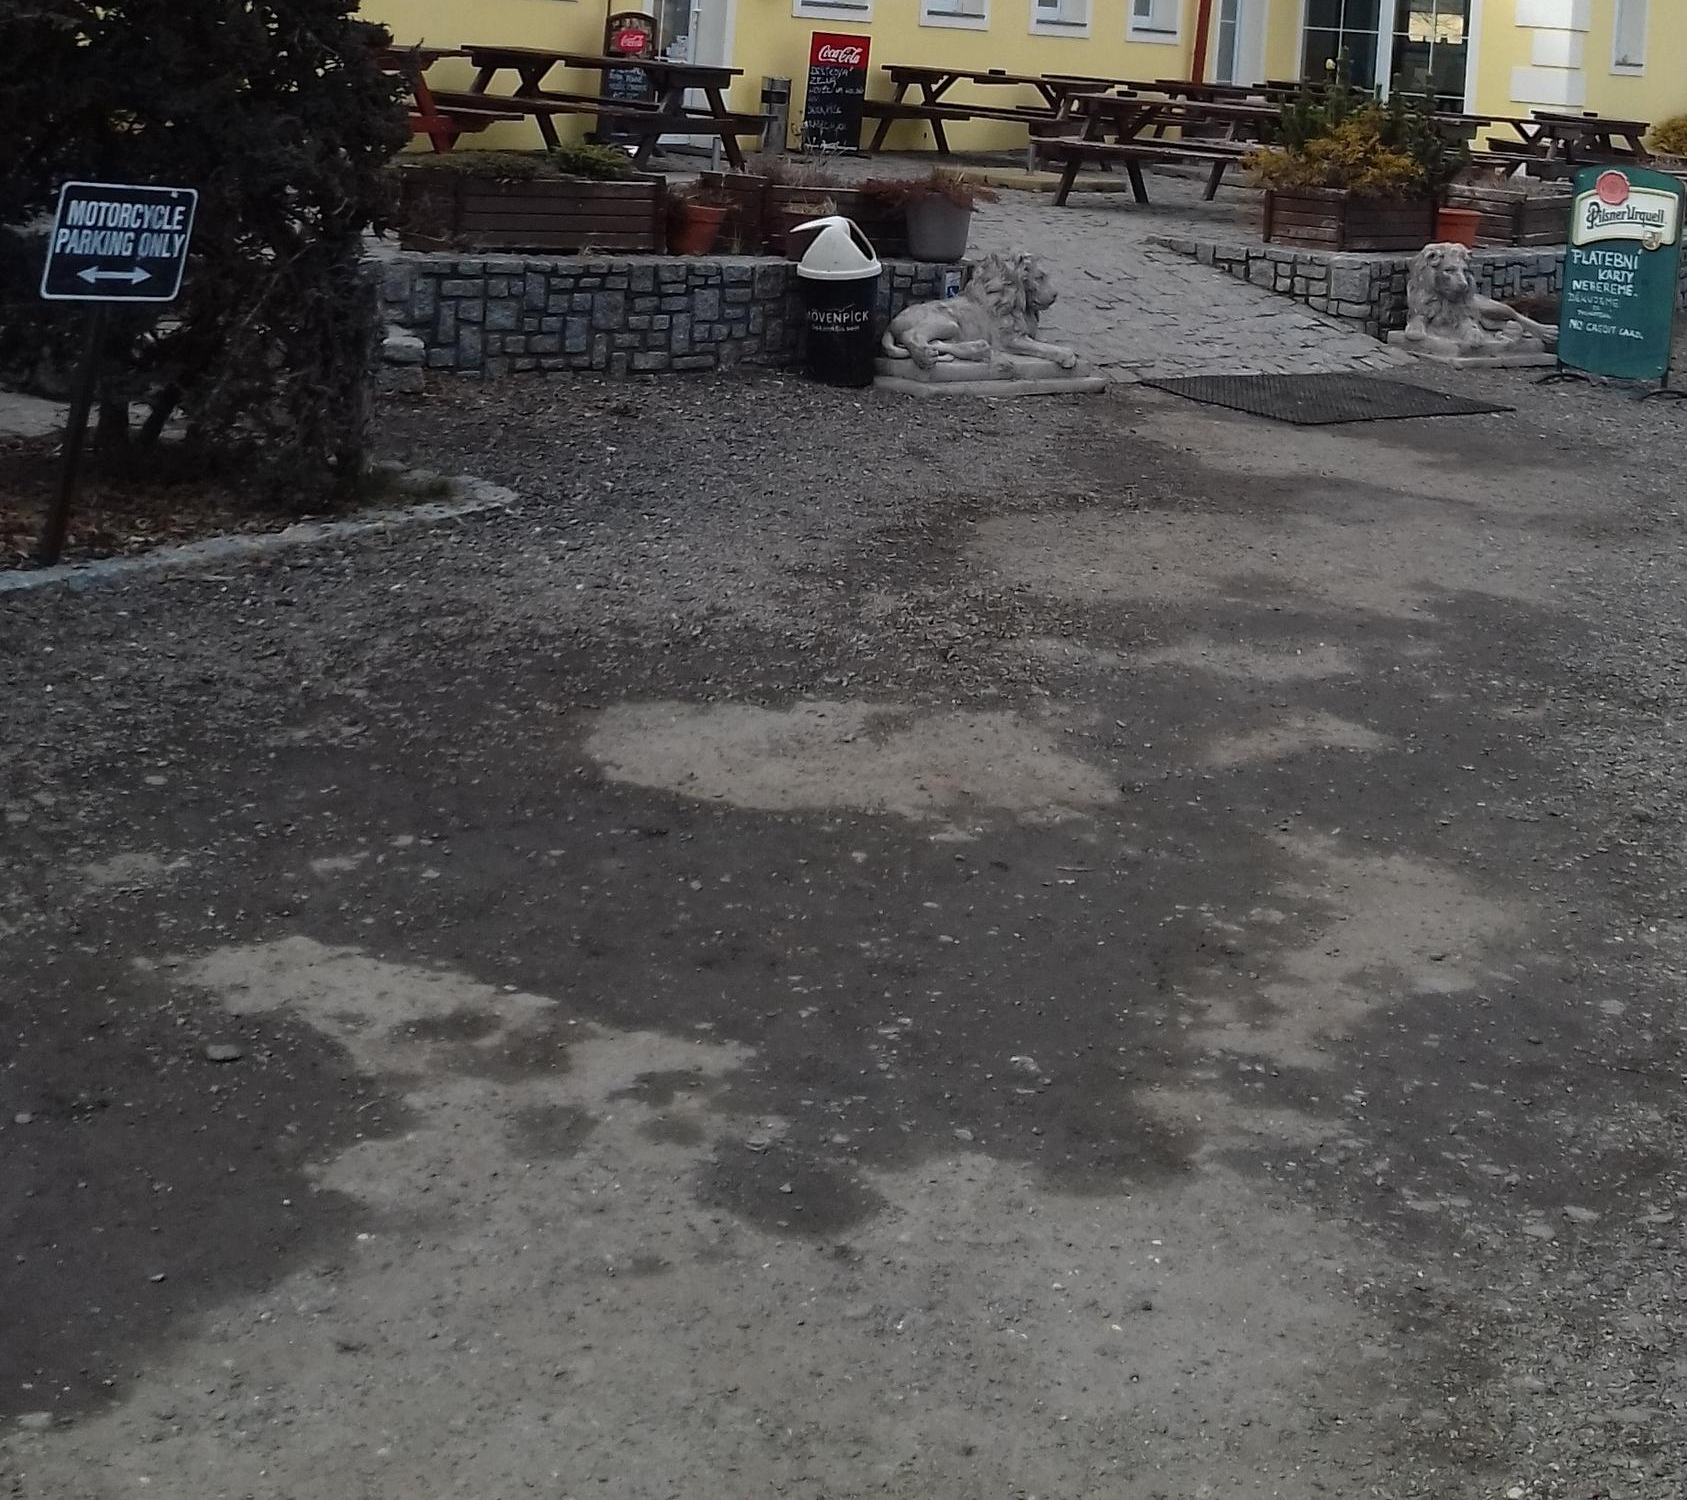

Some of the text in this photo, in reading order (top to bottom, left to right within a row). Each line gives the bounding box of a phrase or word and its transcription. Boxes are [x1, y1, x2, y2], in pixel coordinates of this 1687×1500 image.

[66, 199, 187, 231] MOTORCYCLE
[1586, 201, 1665, 230] Pilsner Urquell
[54, 228, 186, 259] PARKING ONLY
[1570, 248, 1643, 270] PLATEBNÍ
[1598, 268, 1635, 284] KARTY
